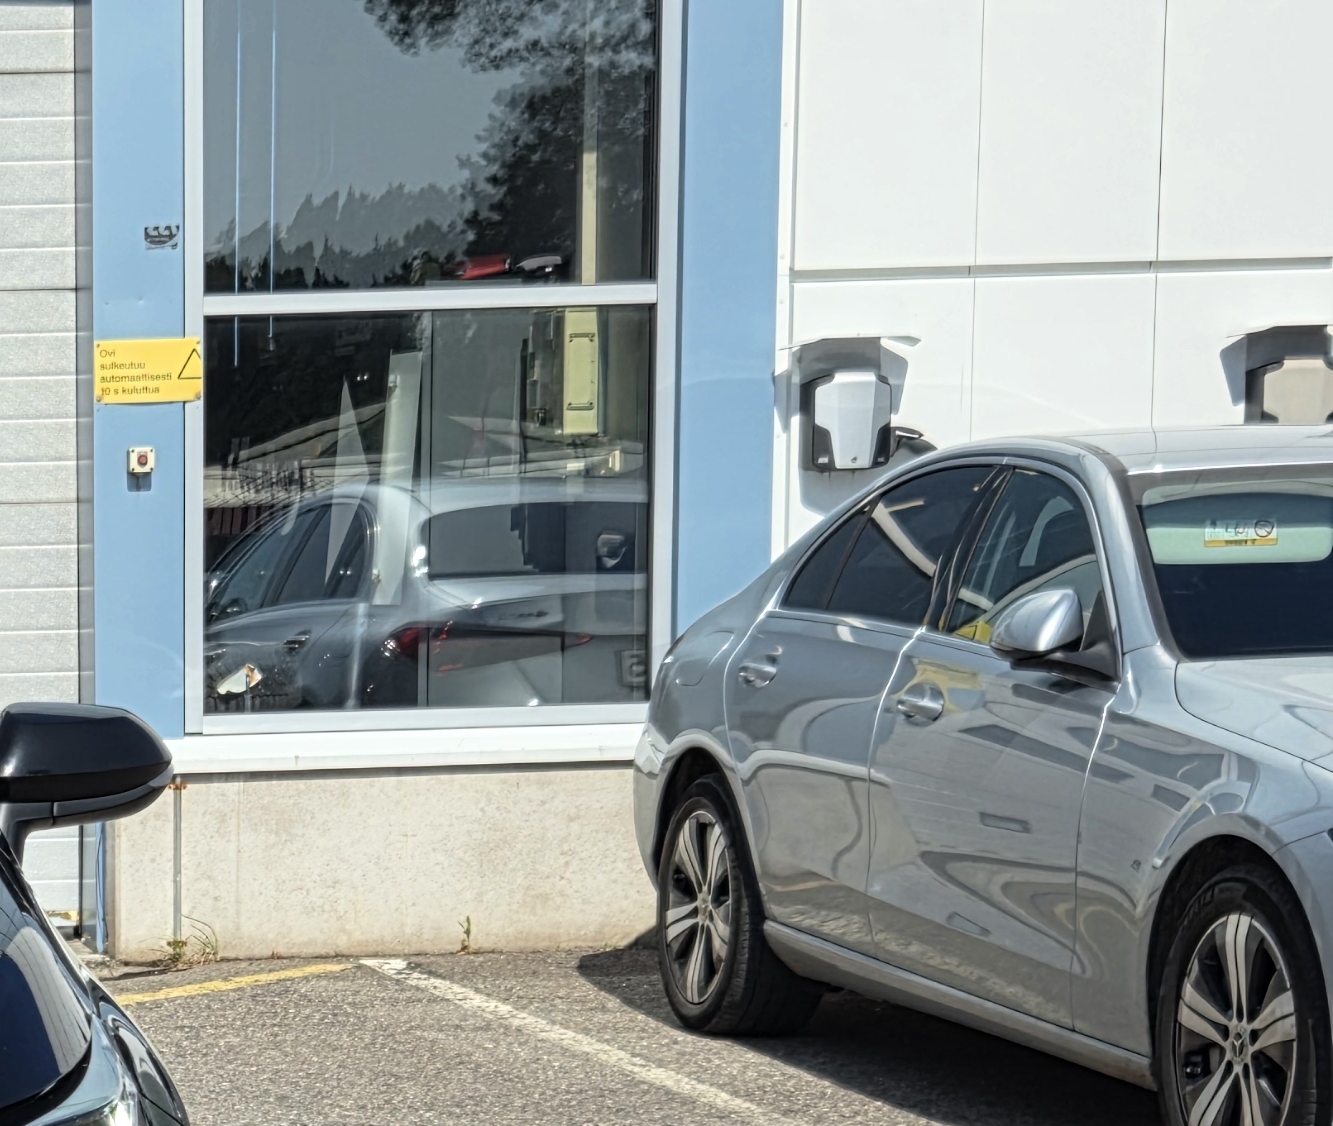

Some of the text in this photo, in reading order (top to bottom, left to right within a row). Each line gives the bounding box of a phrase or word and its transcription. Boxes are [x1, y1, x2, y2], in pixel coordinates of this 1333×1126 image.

[99, 349, 116, 358] Ovi
[99, 361, 146, 371] sulkeutuu
[99, 372, 173, 384] automaattisesti
[121, 386, 160, 395] kuluttua
